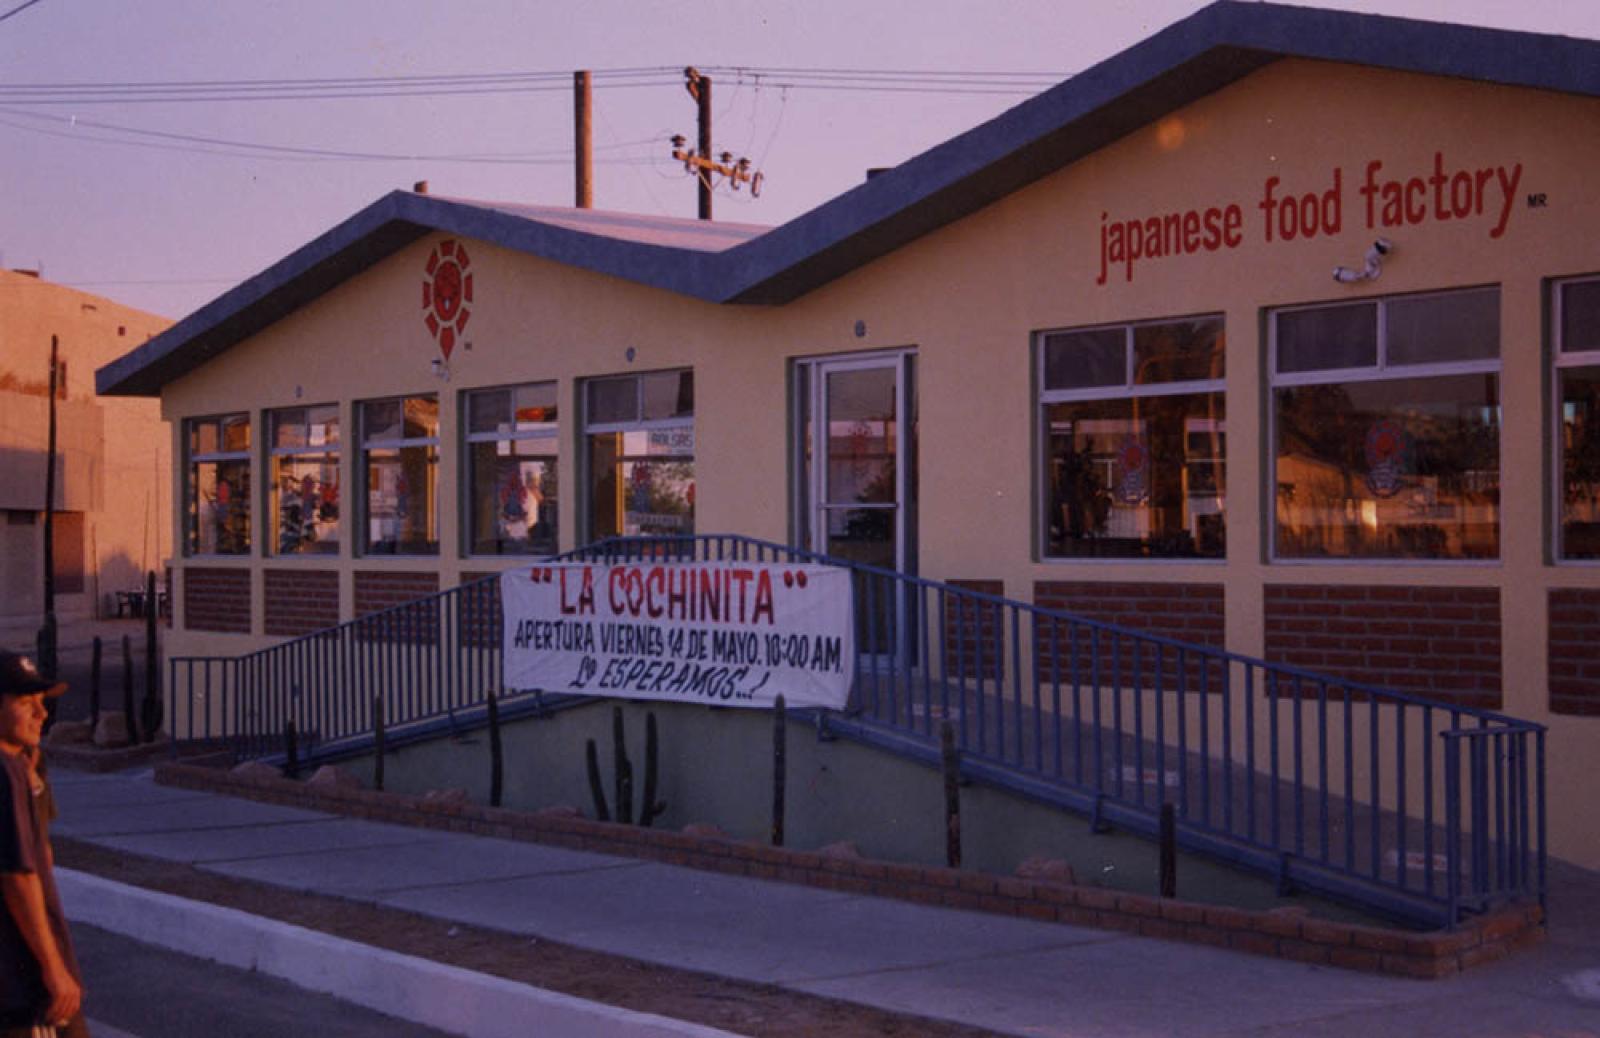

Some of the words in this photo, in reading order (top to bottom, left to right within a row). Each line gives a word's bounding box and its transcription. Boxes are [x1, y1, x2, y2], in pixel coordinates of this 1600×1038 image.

[1097, 205, 1242, 285] japanese
[1259, 167, 1342, 243] food
[1359, 151, 1523, 239] factory
[1527, 192, 1548, 208] MR
[514, 619, 595, 653] APERTURA
[600, 622, 664, 657] VIERNES
[669, 628, 684, 658] 14
[687, 629, 708, 661] DE
[765, 633, 809, 669] 10:00
